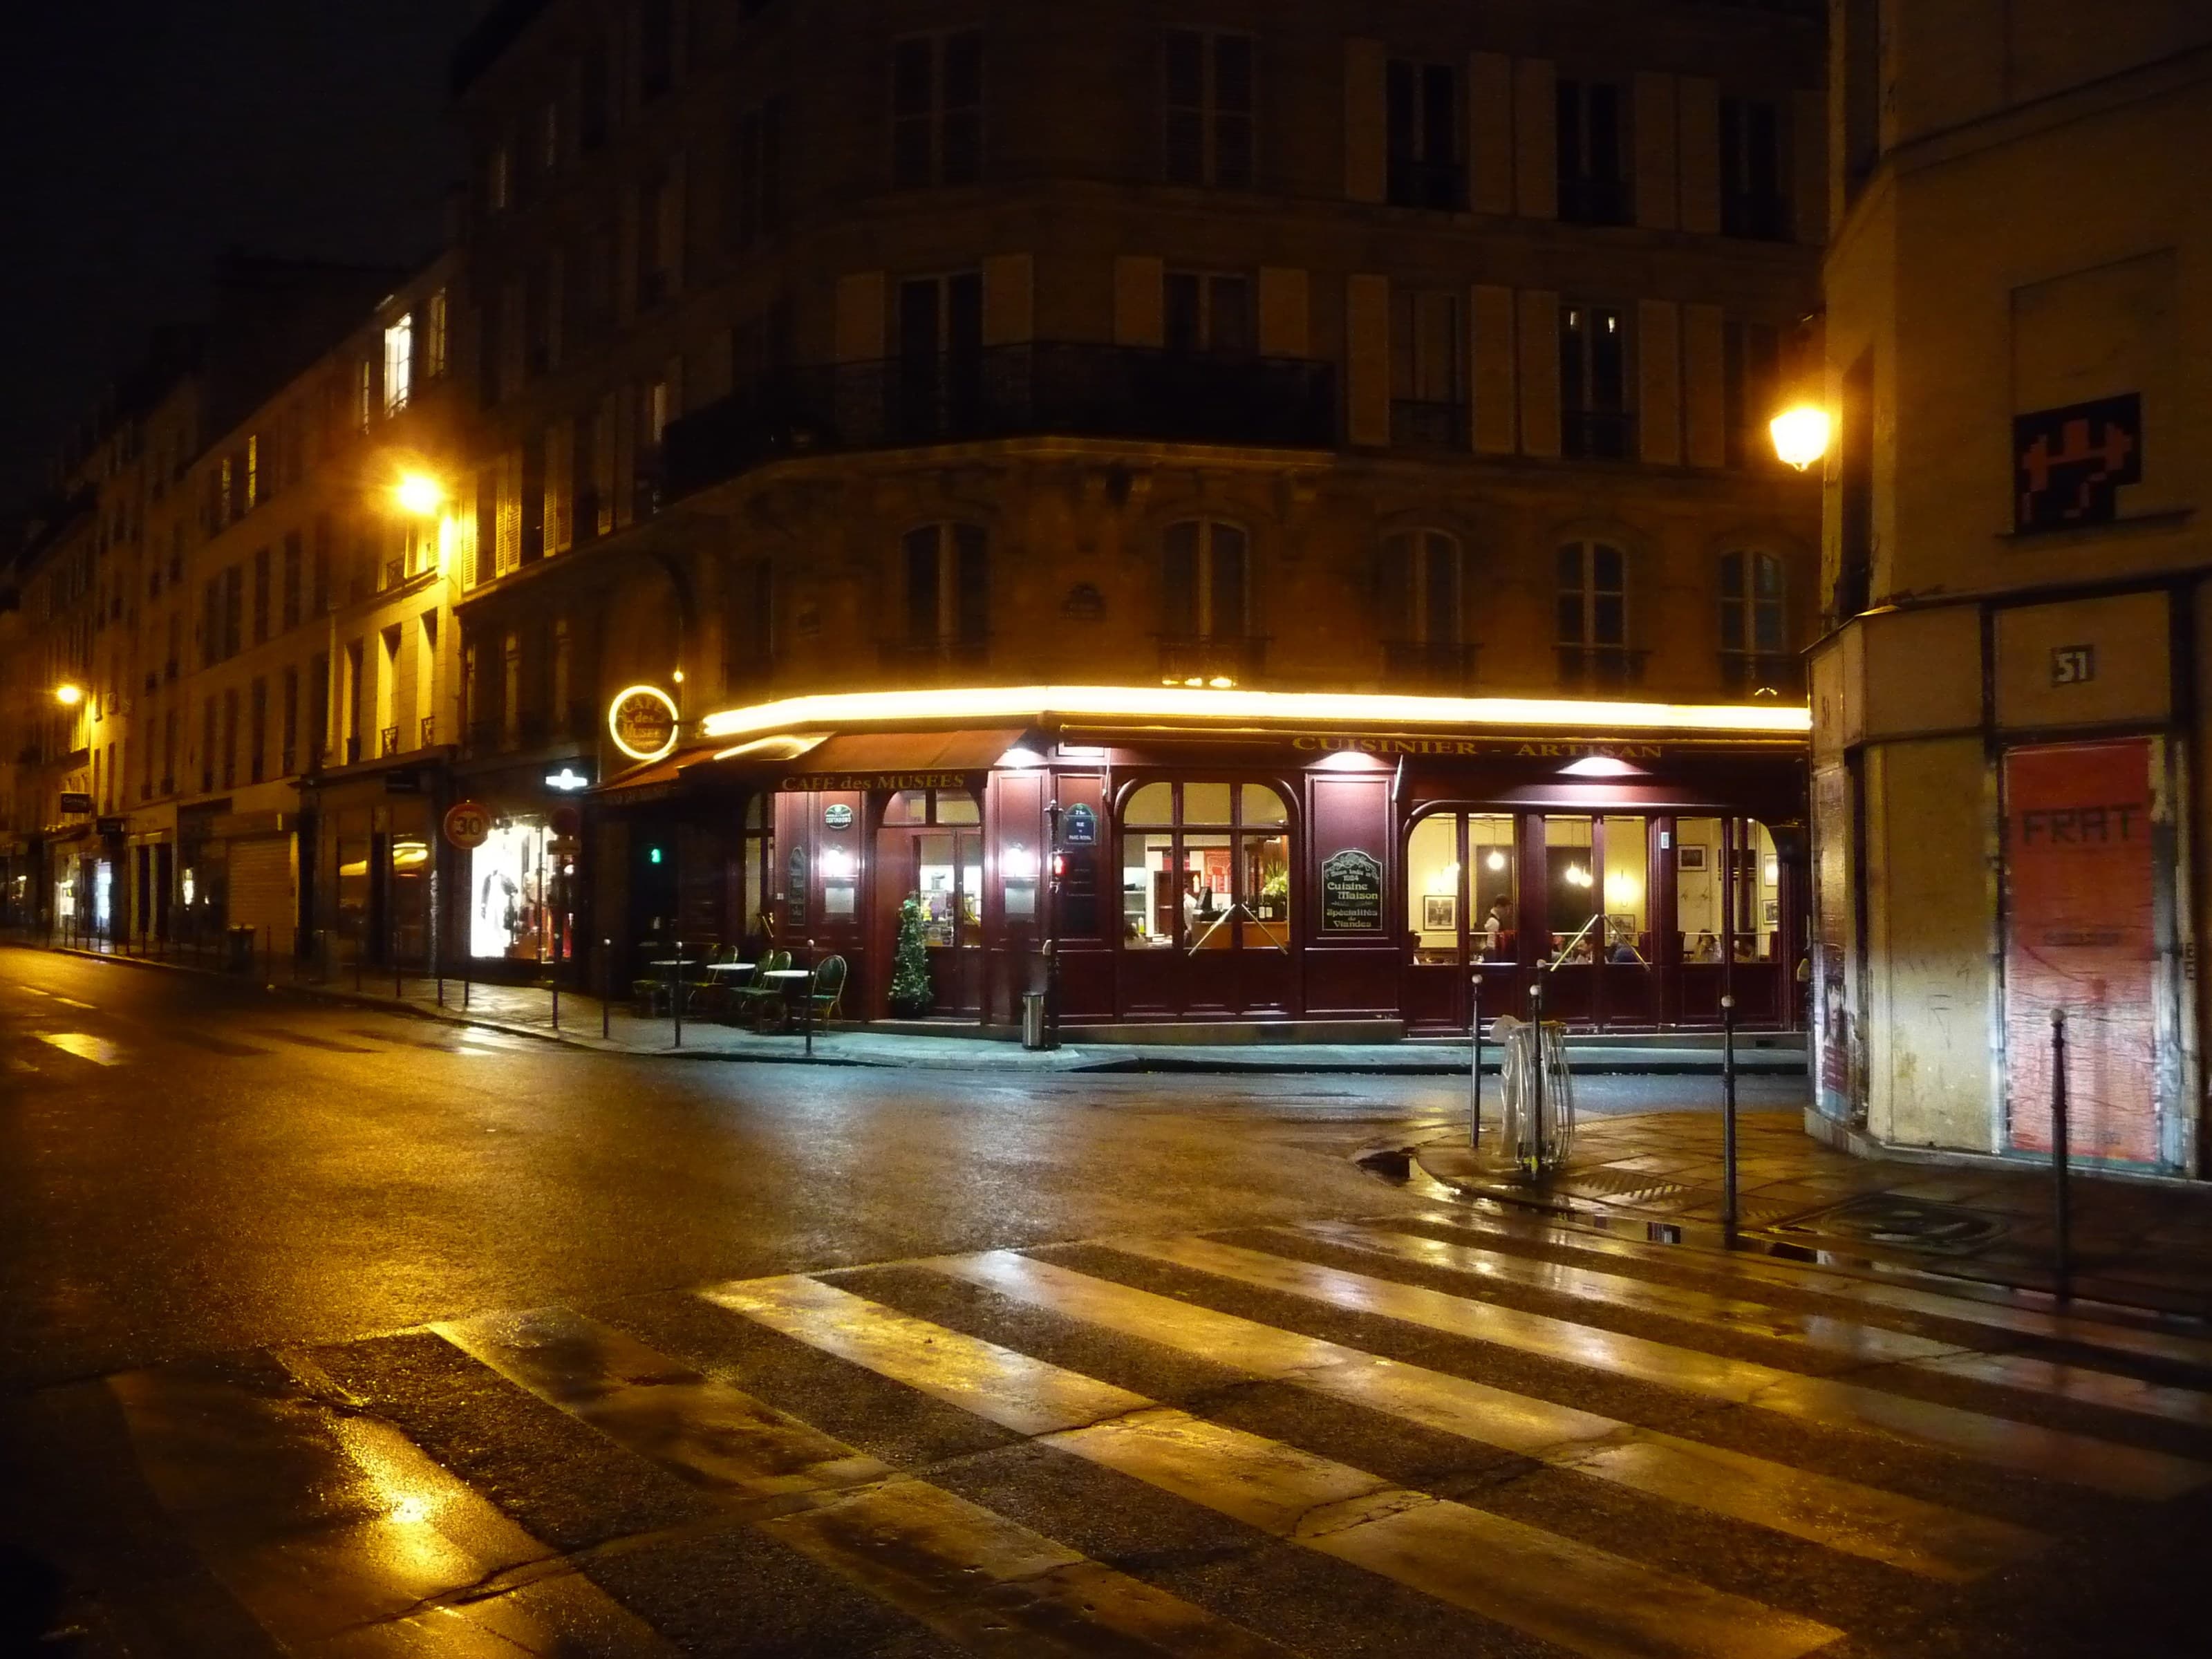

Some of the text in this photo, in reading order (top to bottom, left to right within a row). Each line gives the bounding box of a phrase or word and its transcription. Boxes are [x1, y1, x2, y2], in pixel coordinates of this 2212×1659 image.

[2058, 650, 2086, 682] 51
[1292, 736, 1477, 755] CUISINIER
[1515, 743, 1664, 758] ARTISAN
[841, 775, 872, 789] des
[453, 816, 482, 835] 30
[2023, 803, 2142, 845] FRAT
[1327, 881, 1368, 890] Cuisine
[1337, 891, 1378, 899] Maison
